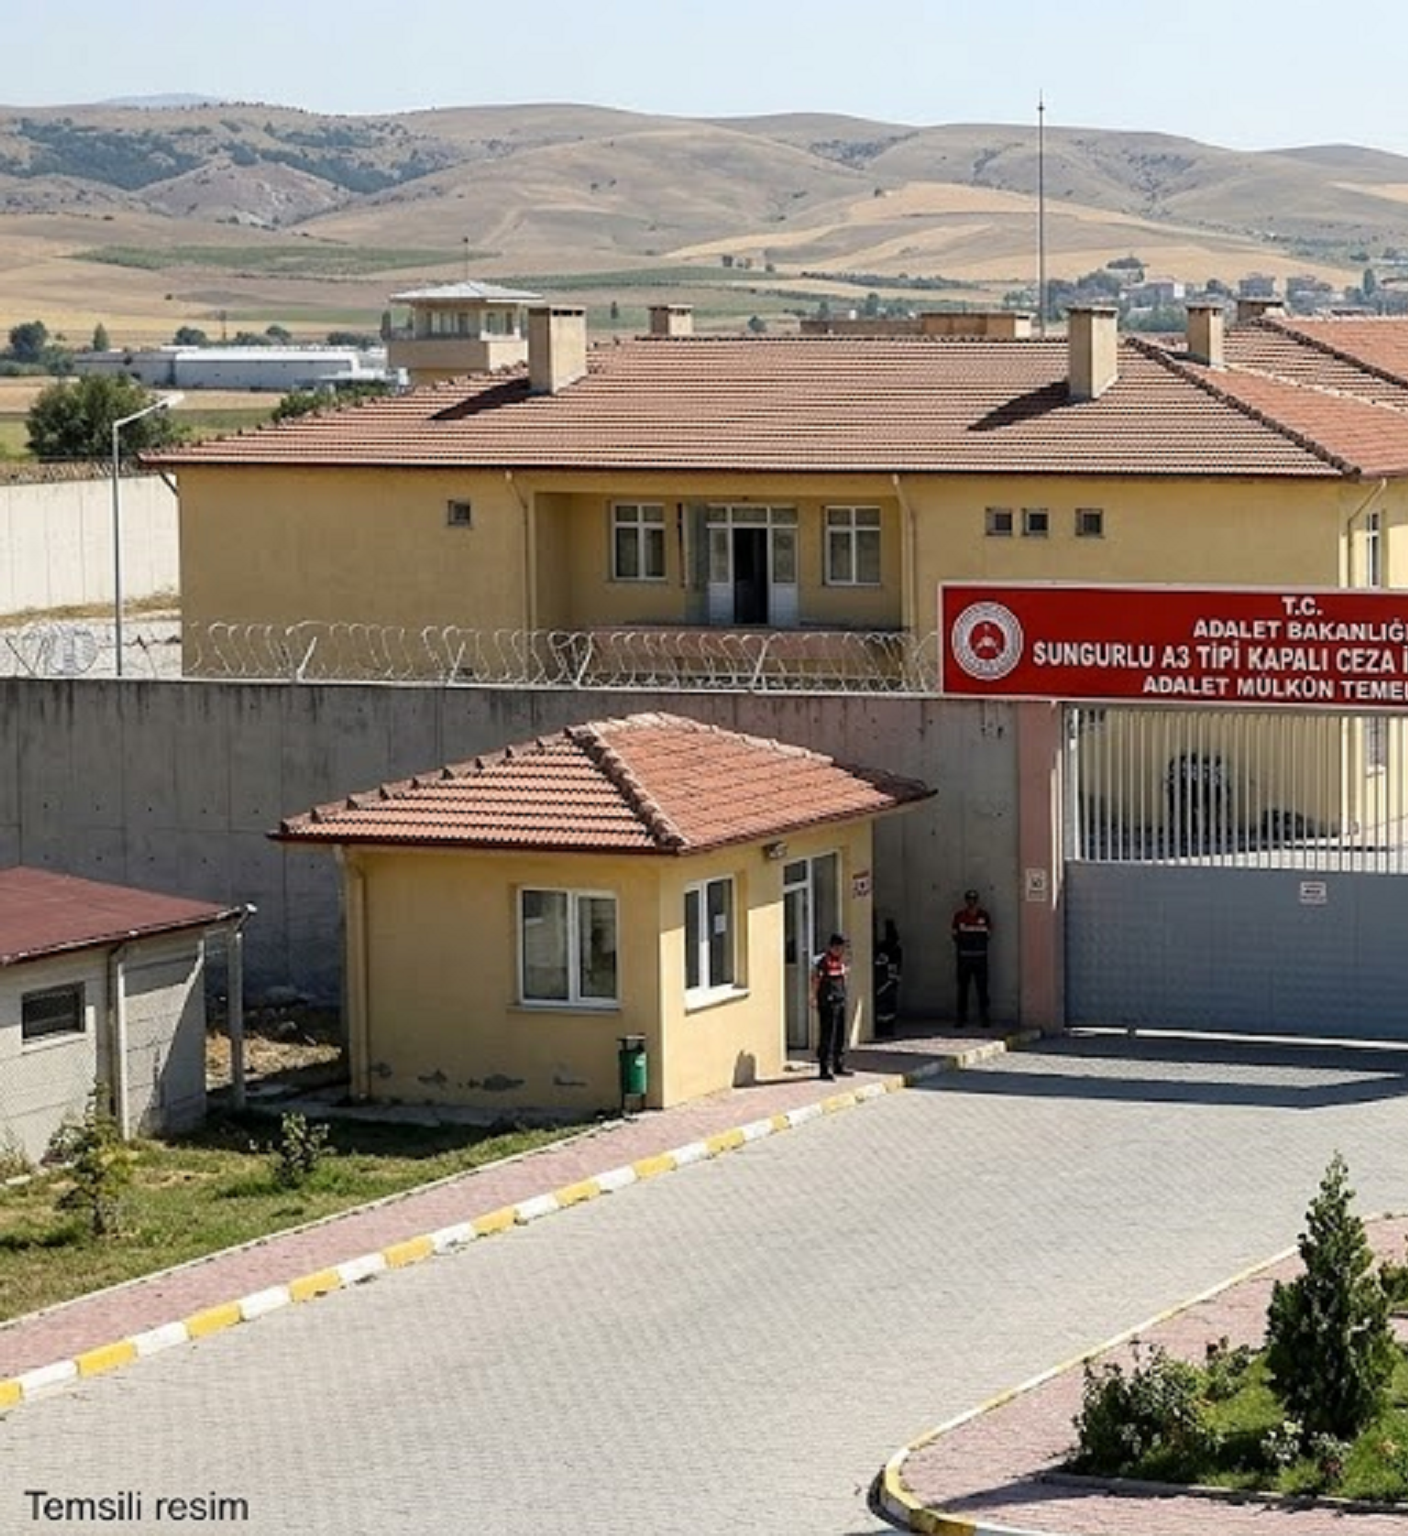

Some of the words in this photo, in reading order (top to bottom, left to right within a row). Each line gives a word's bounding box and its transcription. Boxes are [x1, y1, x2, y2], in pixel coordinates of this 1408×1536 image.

[1281, 596, 1324, 616] T.C.
[1193, 619, 1282, 639] ADALET
[1033, 640, 1154, 669] SUNGURLU
[1161, 645, 1190, 669] A3
[1196, 640, 1240, 670] TİPİ
[1248, 646, 1328, 671] KAPALI
[1336, 647, 1396, 674] CEZA
[1143, 675, 1229, 696] ADALET
